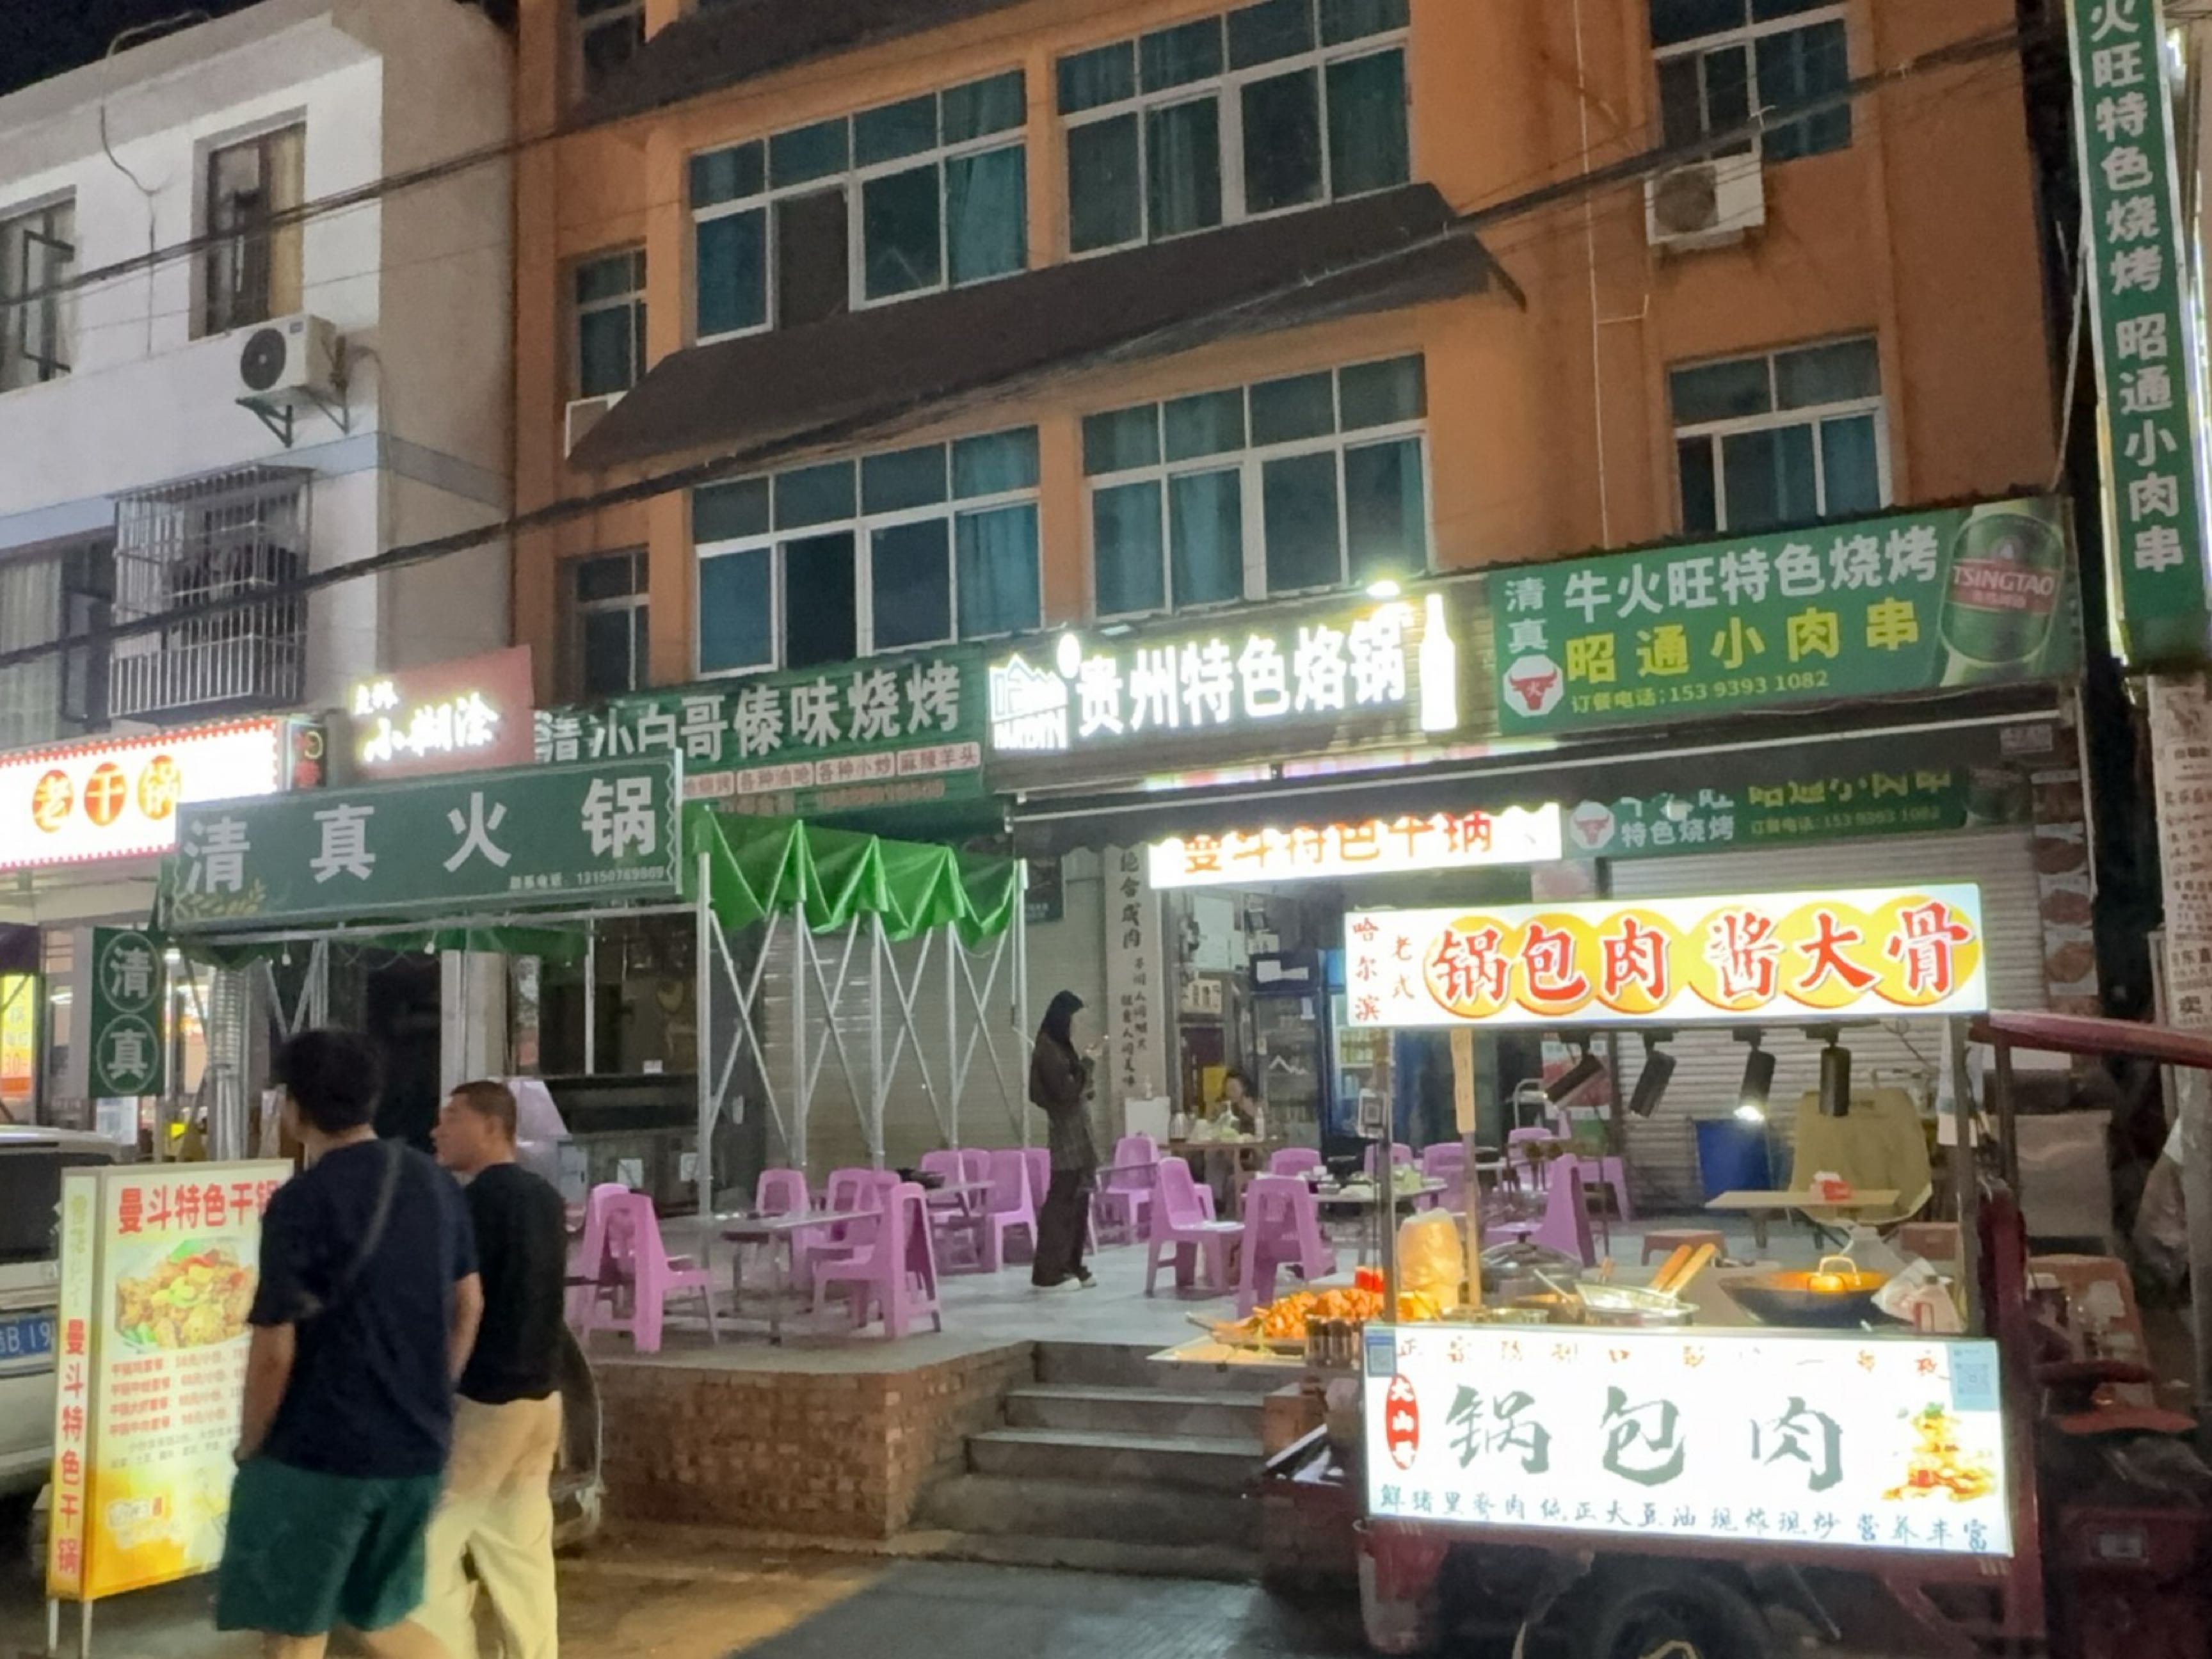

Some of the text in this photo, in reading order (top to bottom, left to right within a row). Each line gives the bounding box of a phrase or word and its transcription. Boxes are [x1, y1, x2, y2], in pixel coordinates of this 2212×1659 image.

[2088, 0, 2185, 574] 火旺特色烧烤 昭通小肉串
[1504, 576, 1549, 655] 清真
[1564, 525, 1939, 624] 牛火旺特色烧烤
[1952, 565, 2056, 596] TSINGTAO
[1075, 604, 1411, 737] 贵州特色烙锅
[1566, 597, 1920, 685] 昭通小肉串
[1713, 675, 1768, 700] 9393
[1775, 669, 1831, 692] 1082
[33, 757, 181, 831] 老干锅
[183, 777, 657, 895] 清真火锅
[1622, 815, 1734, 848] 特色烧烤
[1352, 917, 1380, 1022] 哈尔滨
[1431, 901, 1976, 1004] 锅包肉 酱大骨
[106, 946, 156, 1082] 清真
[56, 1318, 86, 1575] 曼斗特色干锅
[1445, 1382, 1845, 1493] 锅包肉
